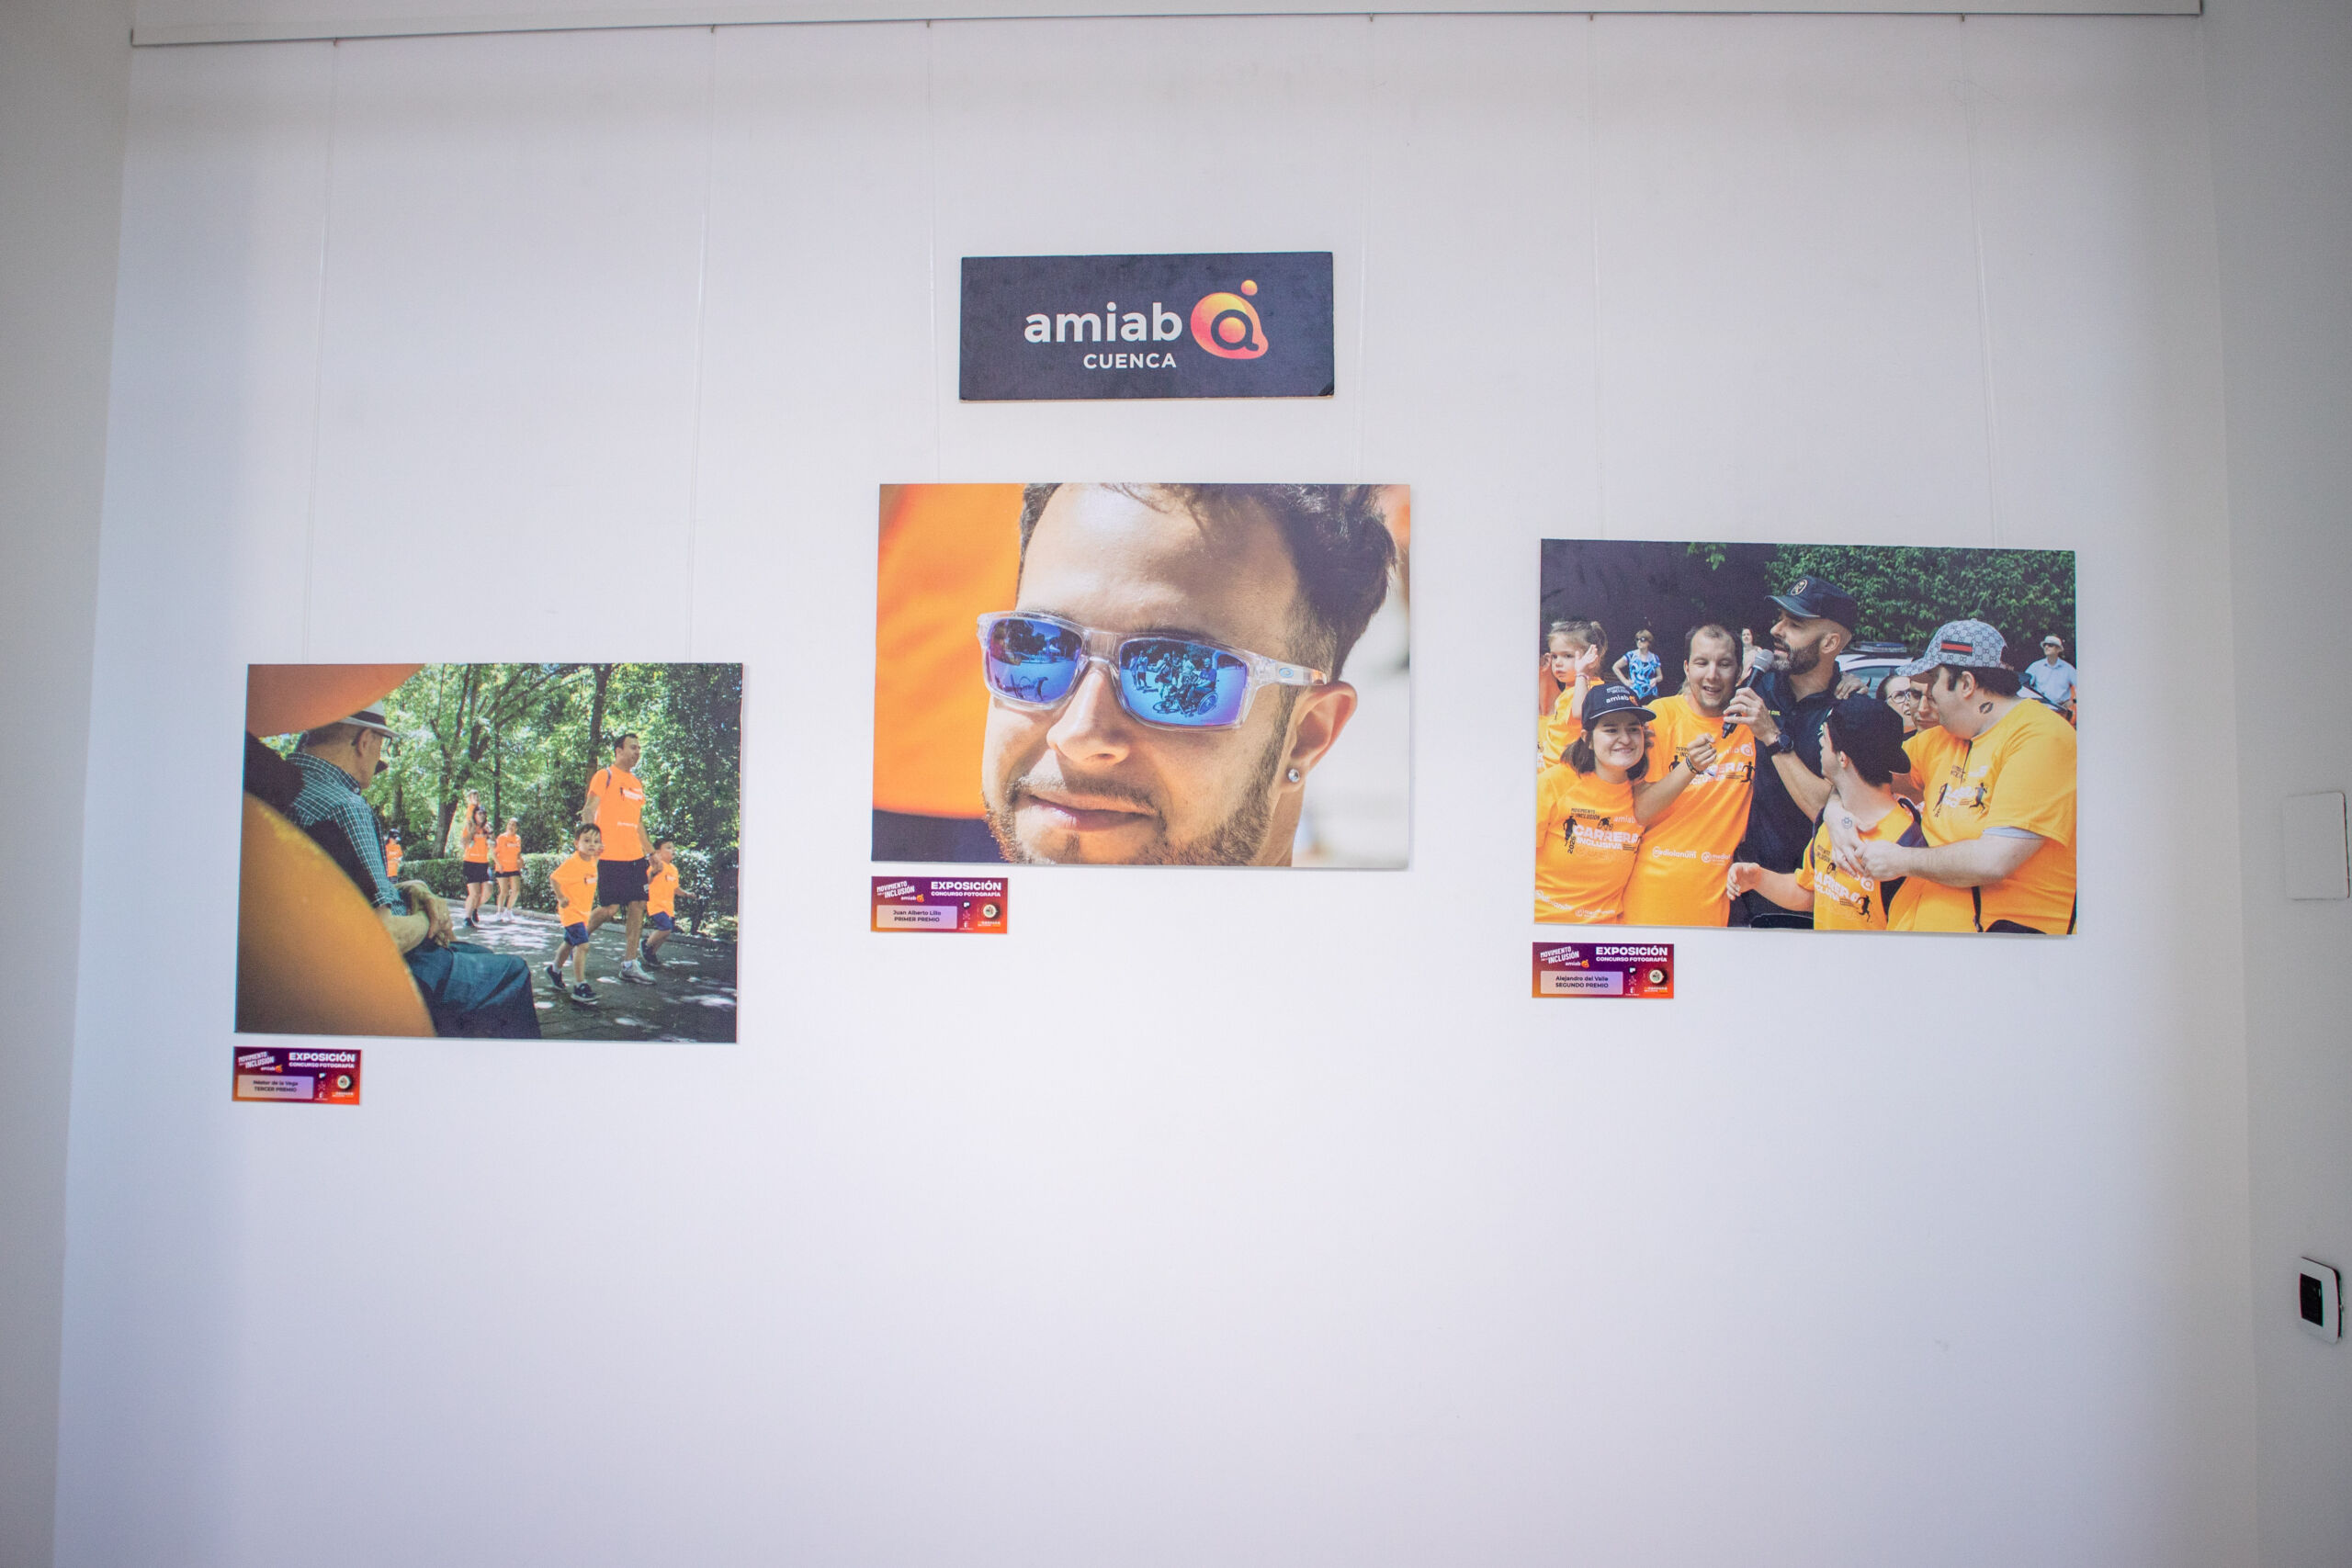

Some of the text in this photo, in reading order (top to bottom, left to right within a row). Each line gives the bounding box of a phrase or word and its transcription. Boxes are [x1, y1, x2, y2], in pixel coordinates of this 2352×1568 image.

[1023, 301, 1182, 343] amiab
[1082, 353, 1177, 369] CUENCA
[1606, 694, 1630, 704] amiab
[1572, 823, 1640, 844] CARRERA
[1576, 837, 1623, 851] INCLUSIVA
[876, 881, 908, 893] MOVIMIENTO
[885, 885, 915, 898] INCLUSIÓN
[931, 880, 1001, 891] EXPOSICIÓN
[1540, 946, 1572, 958] MOVIMIENTO
[1595, 945, 1668, 956] EXPOSICIÓN
[1548, 951, 1579, 964] INCLUSIÓN
[288, 1052, 356, 1063] EXPOSICIÓN
